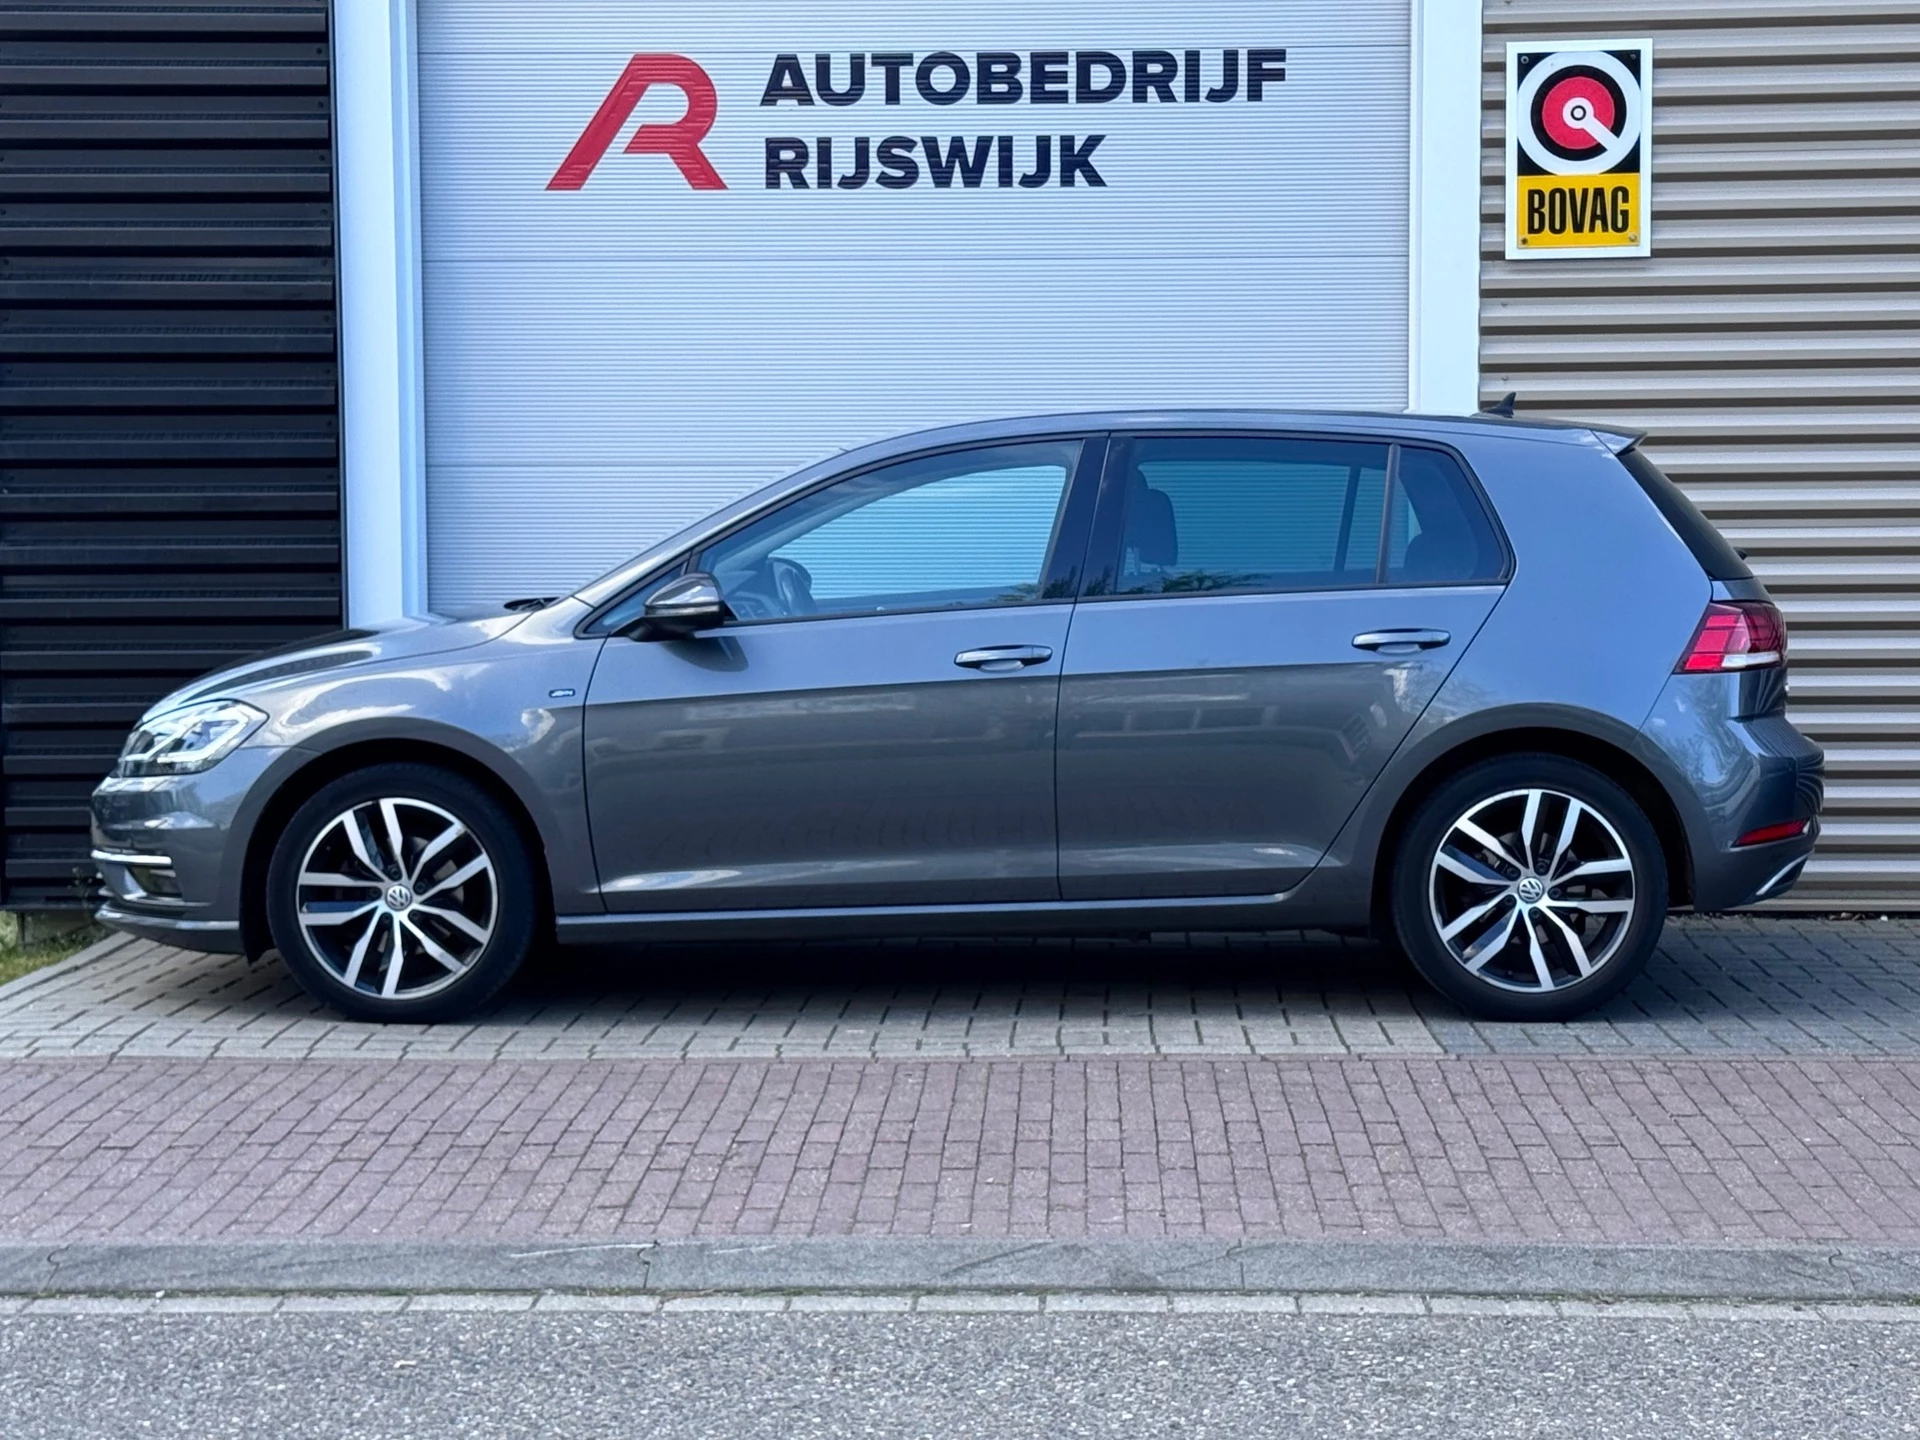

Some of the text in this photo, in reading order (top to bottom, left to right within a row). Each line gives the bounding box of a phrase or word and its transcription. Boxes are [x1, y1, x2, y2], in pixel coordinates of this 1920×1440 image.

[761, 49, 1287, 106] AUTOBEDRIJF
[765, 135, 1107, 190] RIJSWIJK
[1527, 186, 1630, 235] BOVAG
